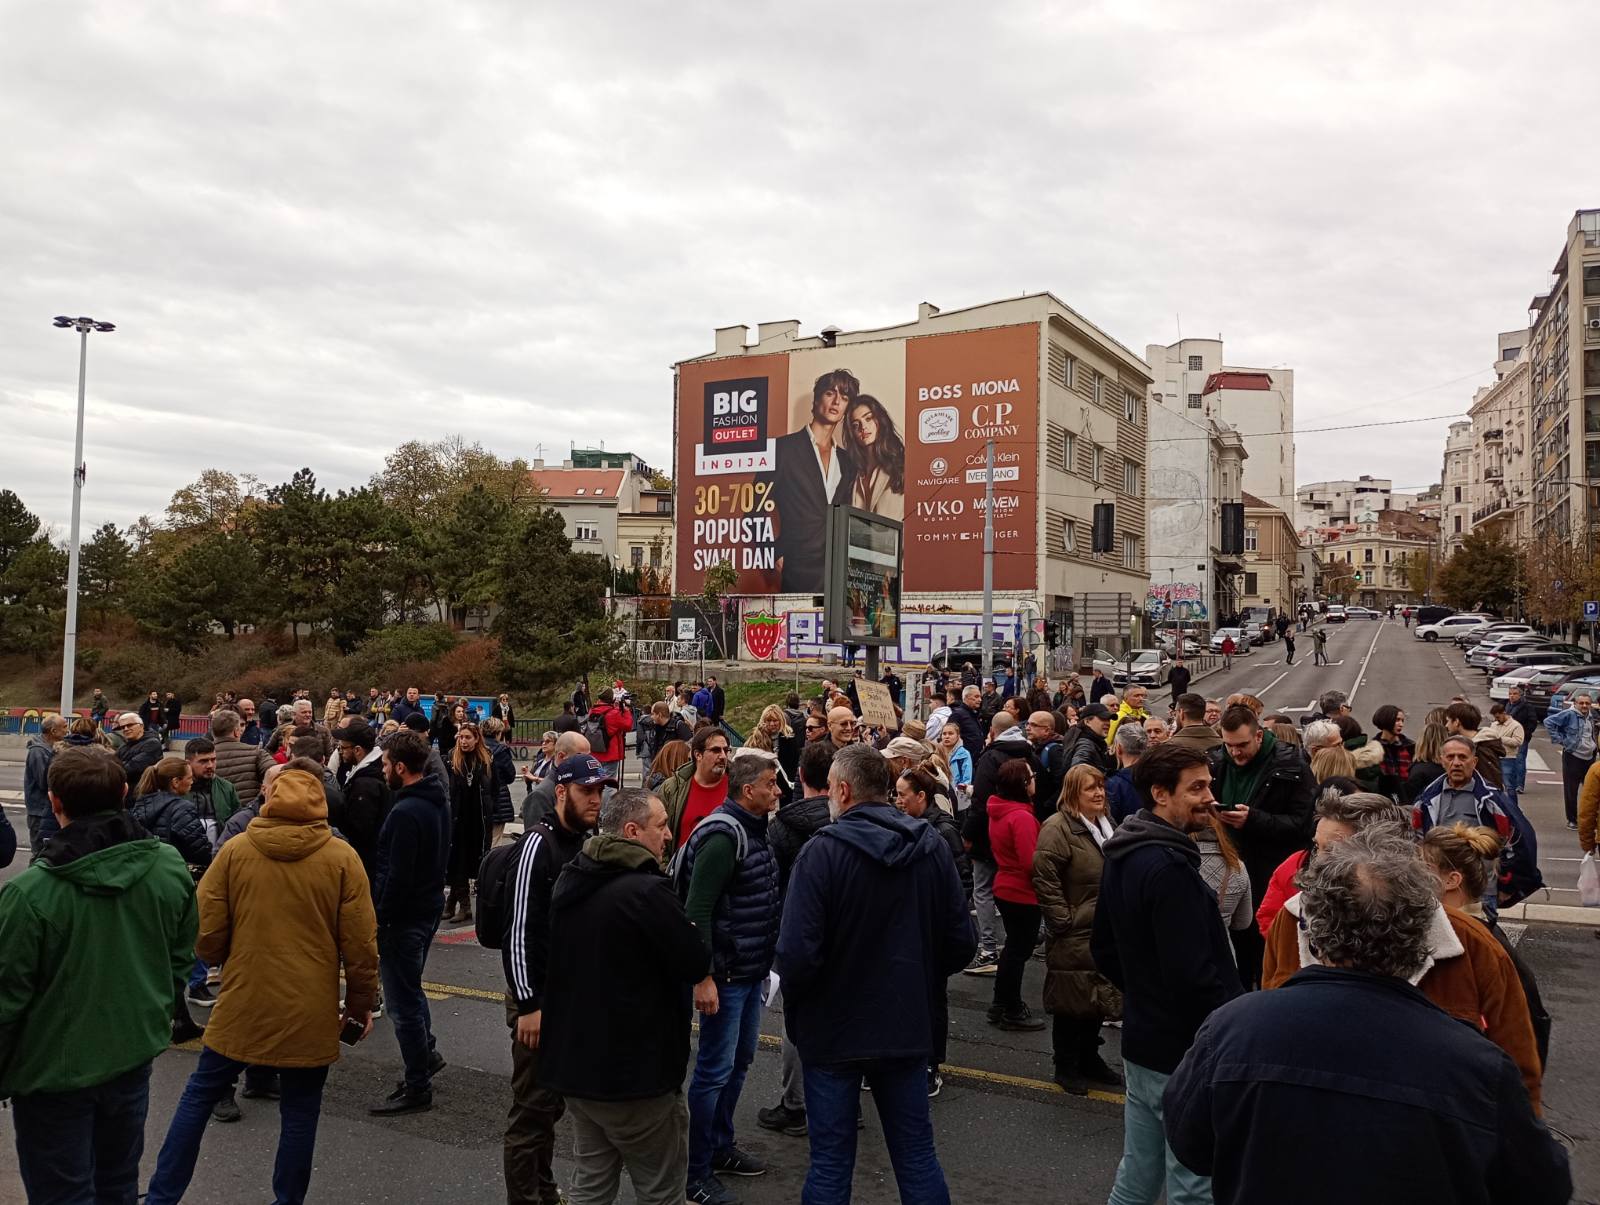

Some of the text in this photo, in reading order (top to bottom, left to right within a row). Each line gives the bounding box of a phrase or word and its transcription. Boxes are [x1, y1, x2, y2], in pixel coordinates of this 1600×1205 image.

[918, 378, 1020, 401] BOSS MONA
[713, 389, 758, 416] BIG
[713, 414, 758, 427] FASHION
[971, 402, 1013, 428] C.P.
[715, 429, 755, 440] OUTLET
[964, 425, 1020, 440] COMPANY
[966, 452, 1020, 465] Calvn Klein
[917, 477, 960, 487] NAVIGARE
[694, 482, 775, 515] 30-70%
[917, 500, 964, 516] IVKO
[694, 517, 775, 545] POPUSTA
[917, 531, 1019, 542] TOMMY HIIGER
[742, 547, 775, 570] DAN
[1586, 602, 1595, 614] P
